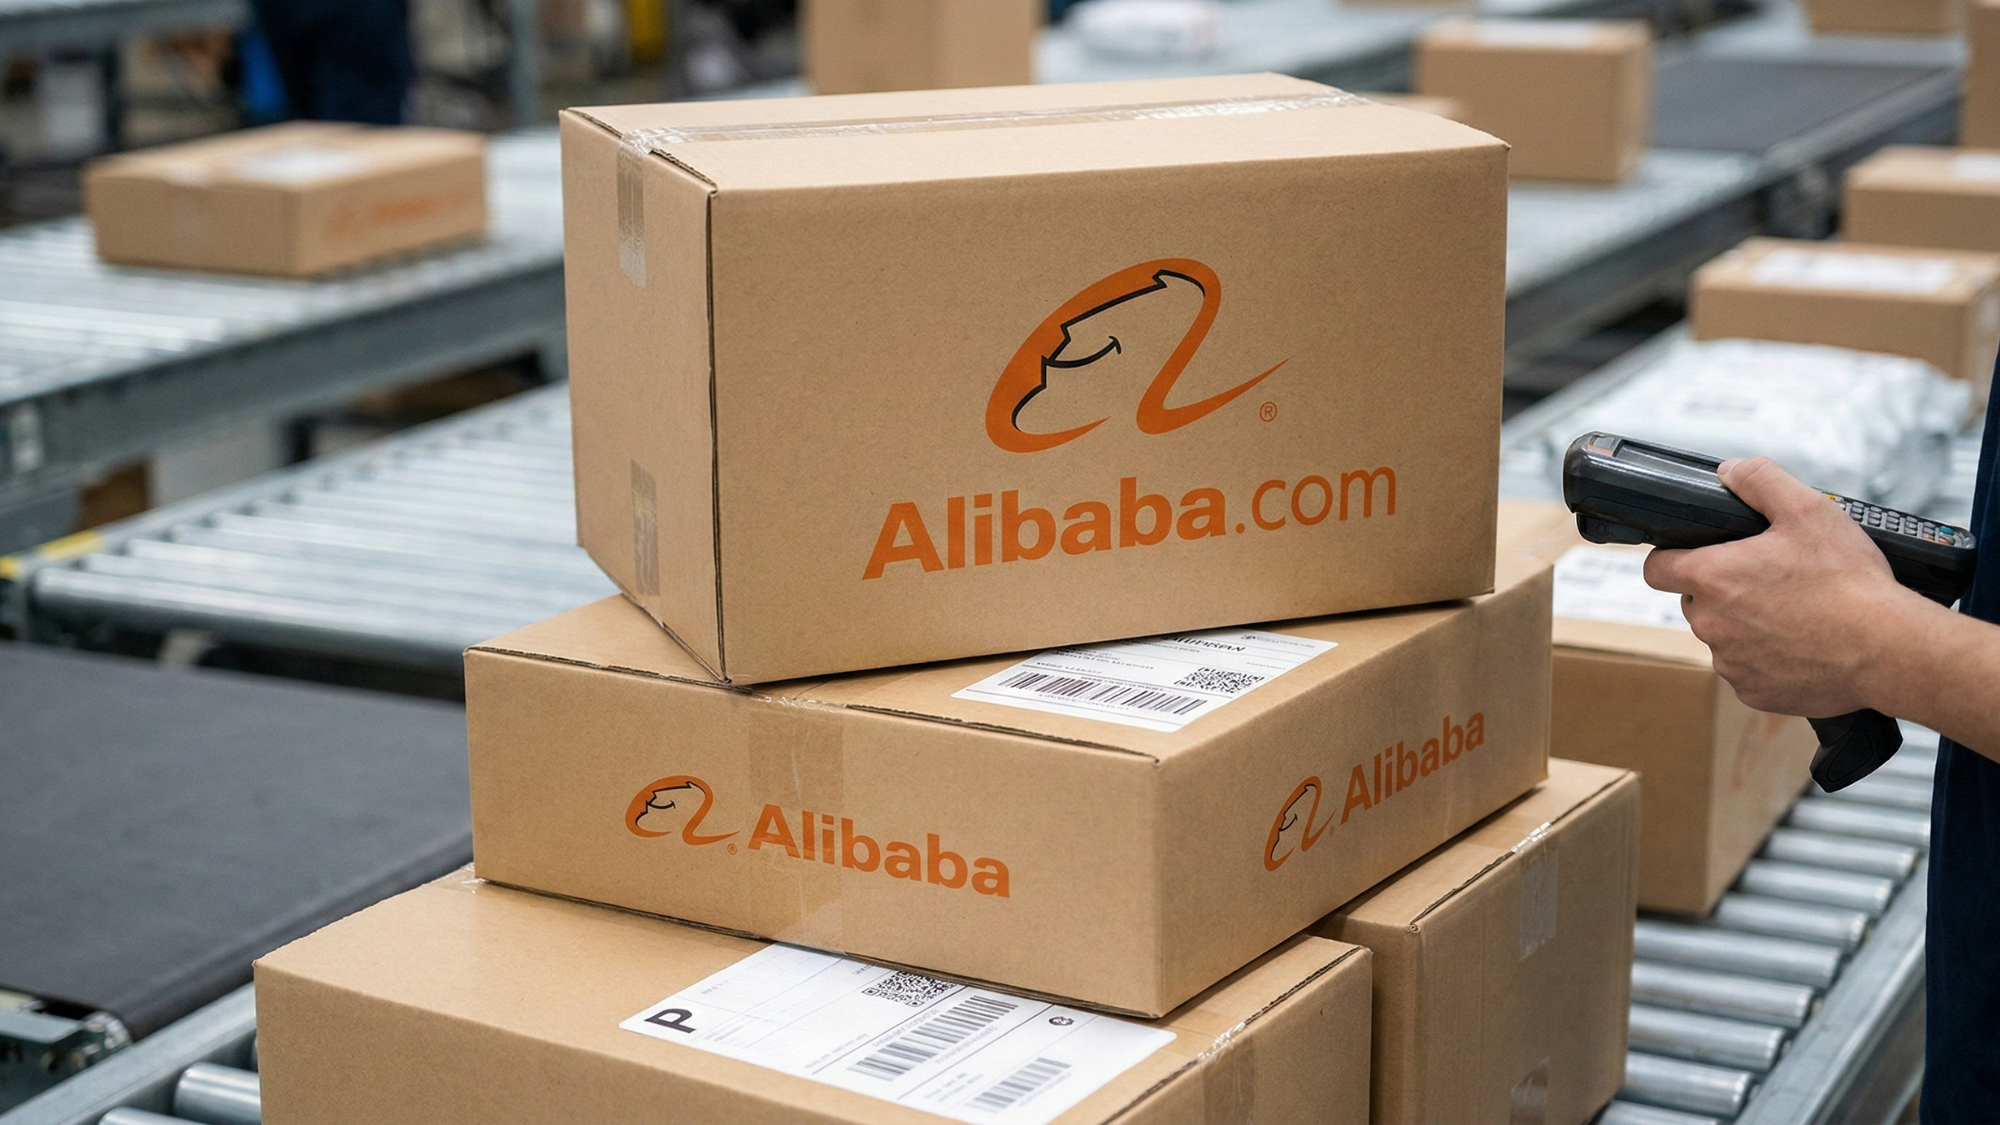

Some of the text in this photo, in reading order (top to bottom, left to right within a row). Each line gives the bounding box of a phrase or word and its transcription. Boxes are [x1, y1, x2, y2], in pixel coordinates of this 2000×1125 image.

[862, 466, 1397, 580] Alibaba.com
[1340, 711, 1485, 825] Alibaba
[747, 803, 1010, 898] Alibaba
[643, 1008, 697, 1033] P
